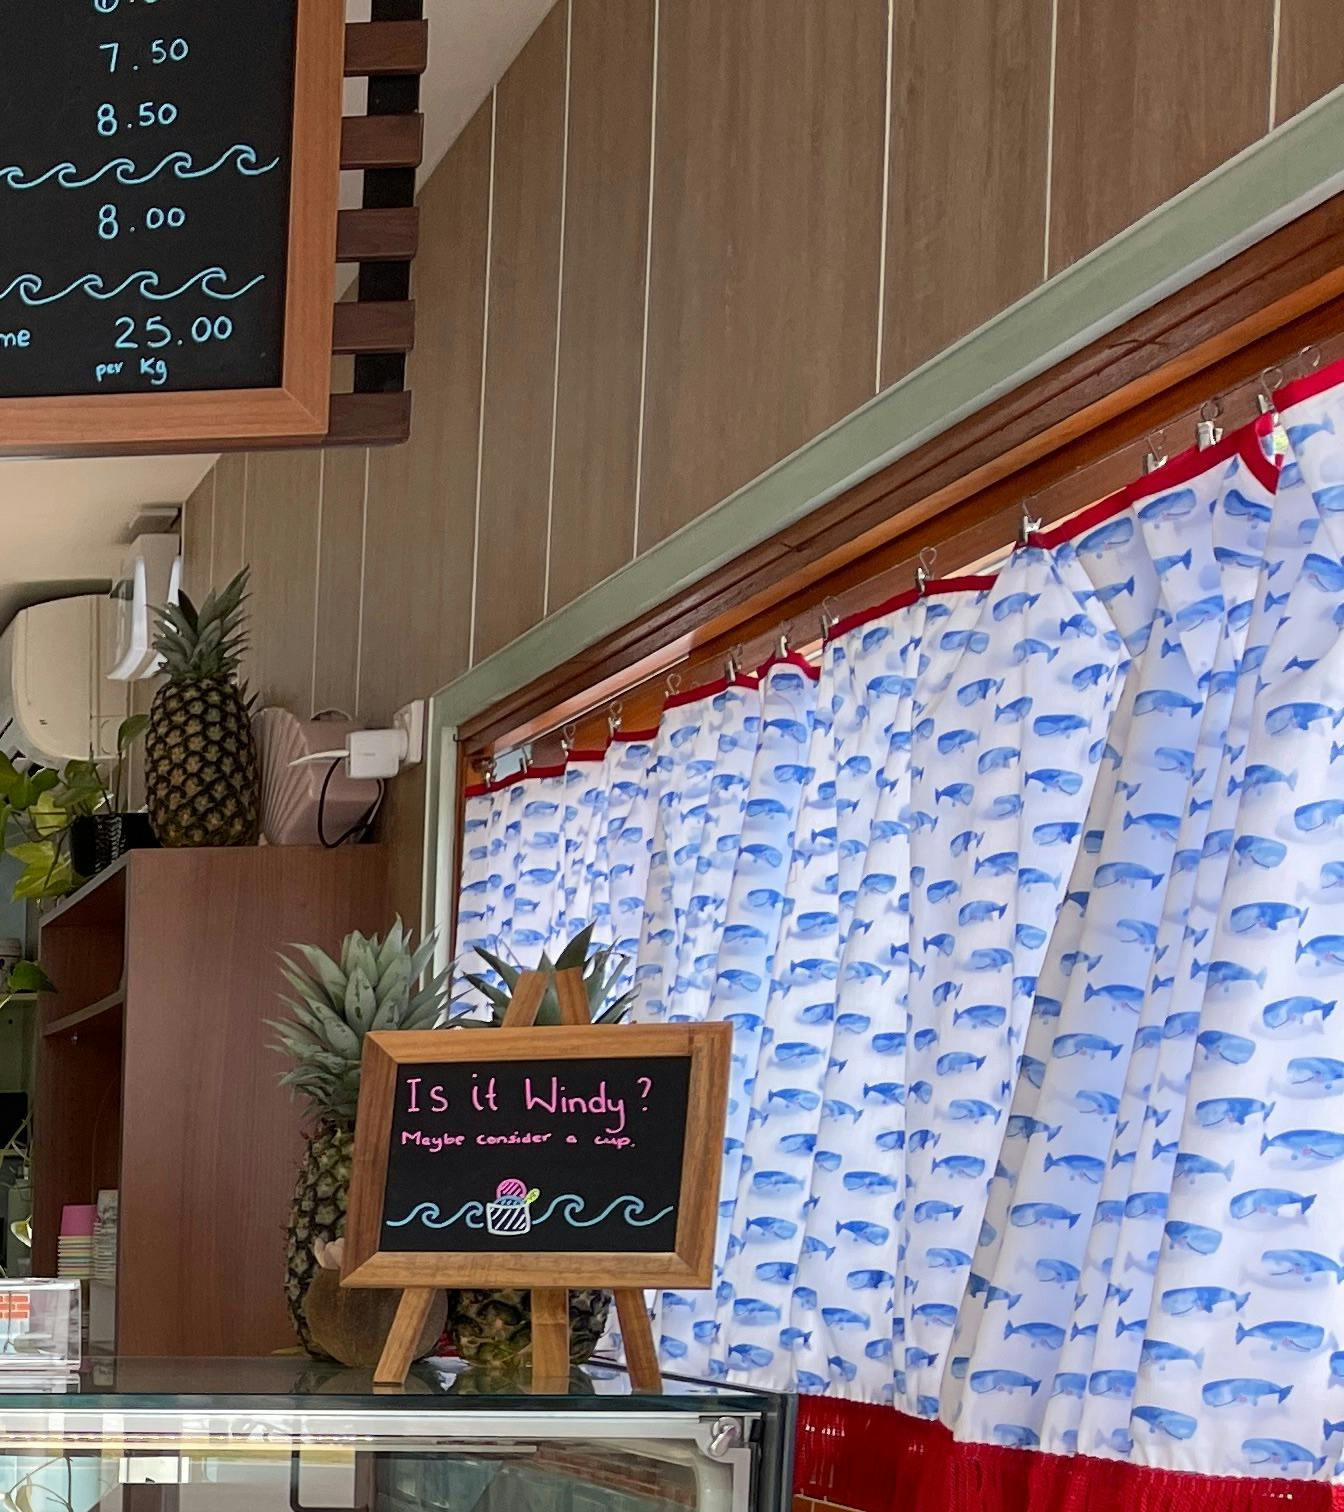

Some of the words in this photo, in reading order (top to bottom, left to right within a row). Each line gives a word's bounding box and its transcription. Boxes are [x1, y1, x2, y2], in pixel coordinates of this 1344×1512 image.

[100, 39, 188, 72] 7.50
[98, 102, 177, 135] 8.50
[99, 204, 185, 239] 8.00
[115, 316, 232, 348] 25.00
[96, 362, 123, 381] per
[407, 1078, 448, 1112] Is
[472, 1074, 497, 1110] it
[402, 1131, 464, 1152] Maybe
[476, 1131, 551, 1144] consider
